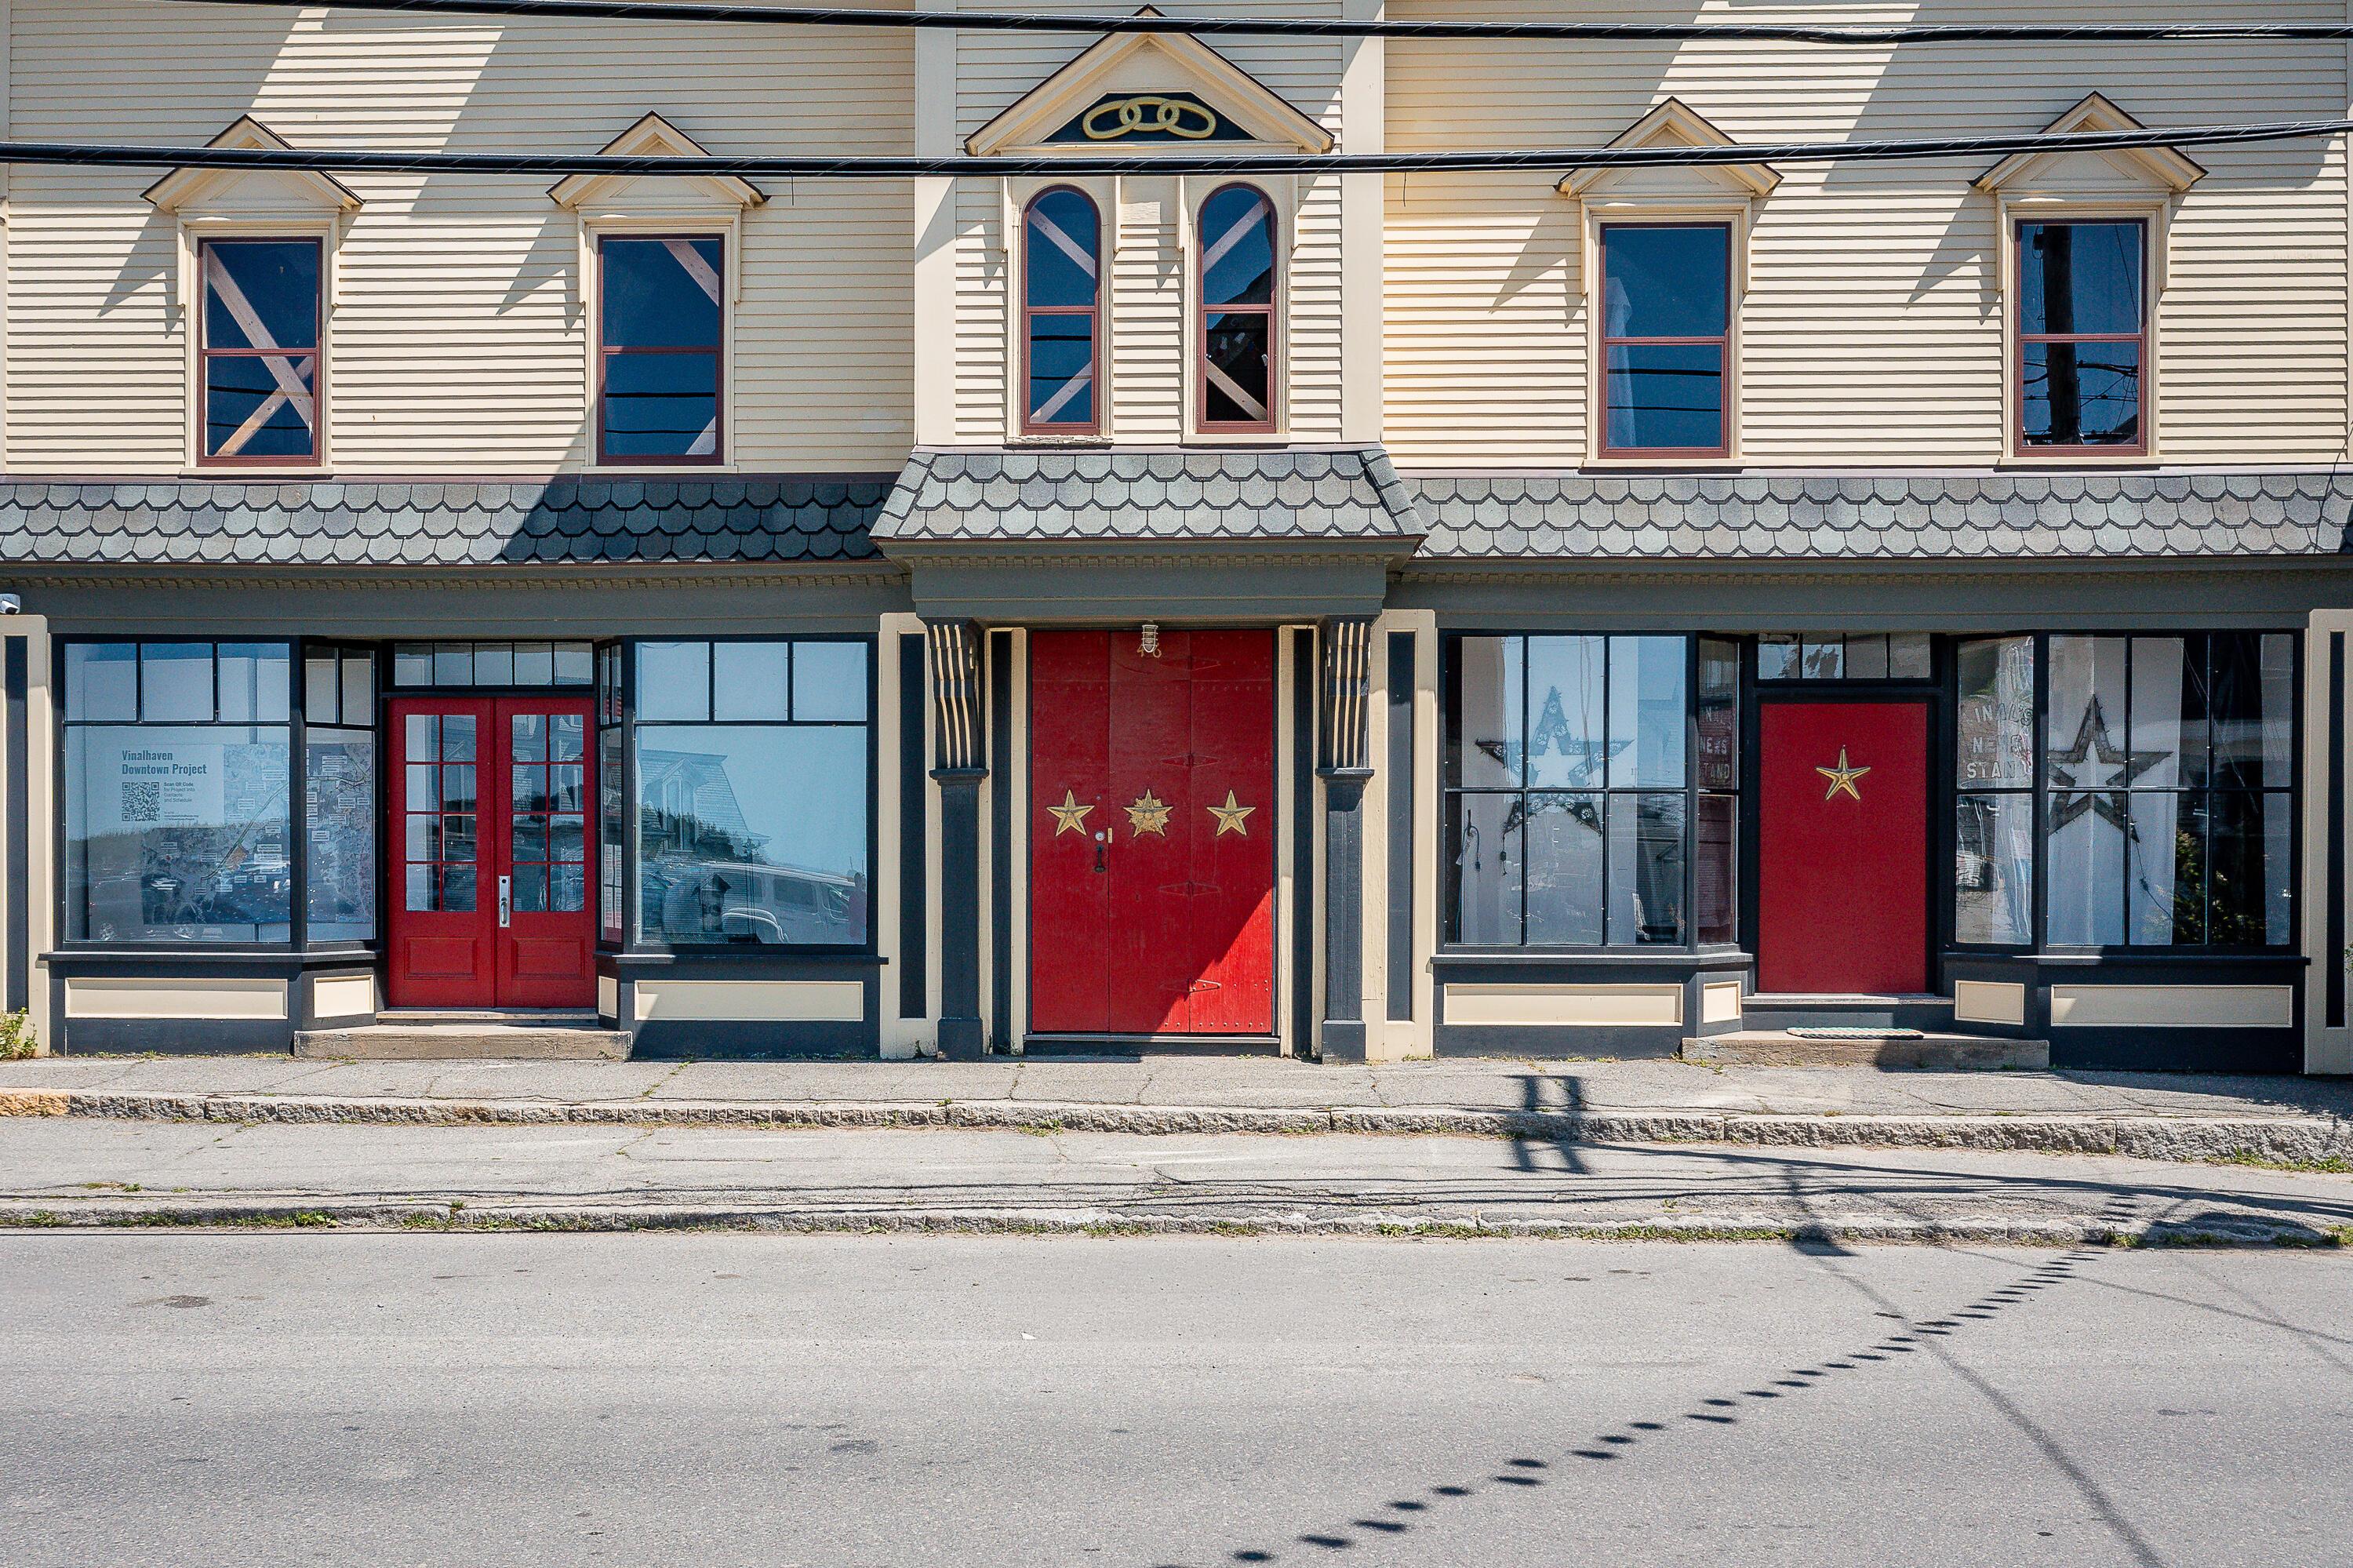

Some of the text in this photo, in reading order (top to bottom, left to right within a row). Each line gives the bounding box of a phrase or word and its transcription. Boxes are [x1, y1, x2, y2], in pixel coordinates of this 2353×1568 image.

[1973, 703, 2033, 726] INAL'S
[1973, 734, 2024, 754] NES
[122, 750, 173, 761] Vinalhaven
[122, 764, 207, 776] Downtown Project
[1966, 761, 2017, 779] STAN
